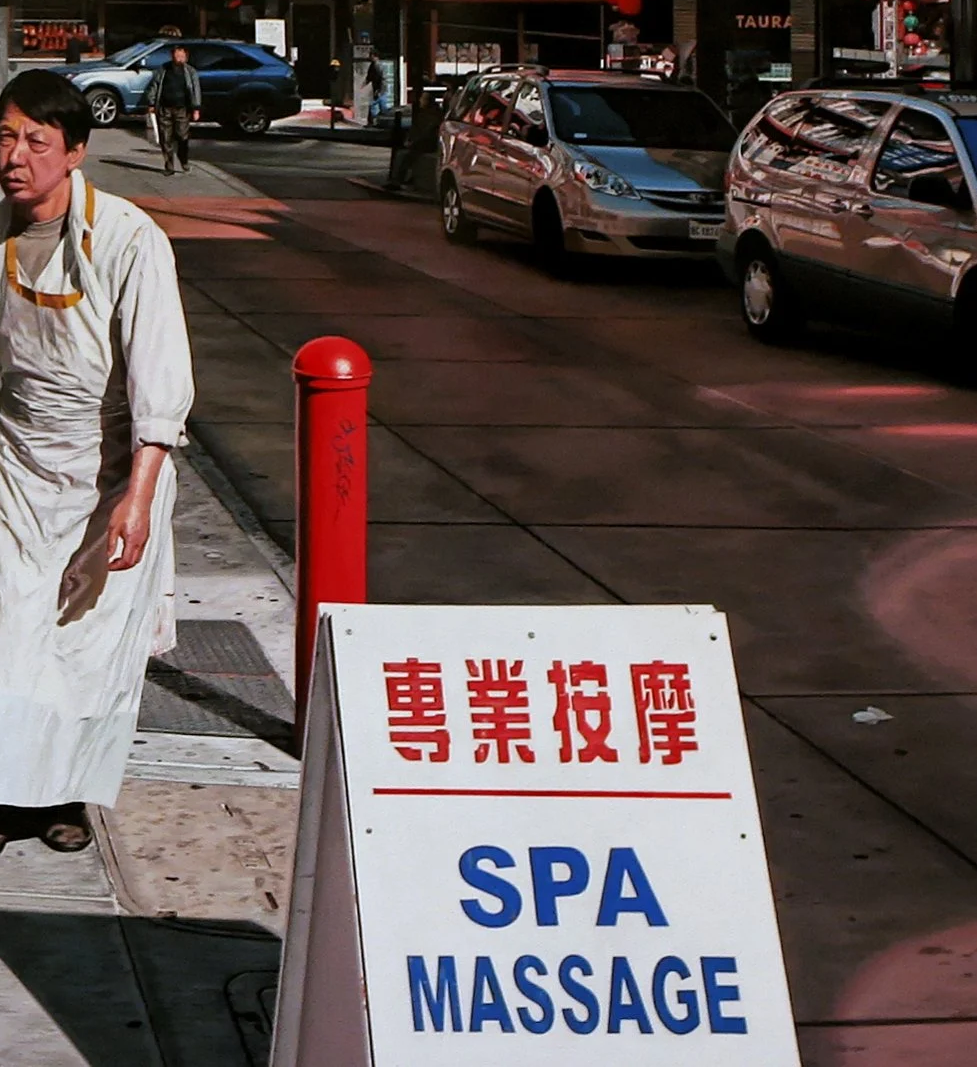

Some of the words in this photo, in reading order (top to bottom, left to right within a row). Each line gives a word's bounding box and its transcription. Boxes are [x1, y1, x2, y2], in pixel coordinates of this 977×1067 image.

[382, 657, 699, 765] 專業按摩
[458, 845, 670, 928] SPA
[406, 954, 748, 1035] MASSAGE
